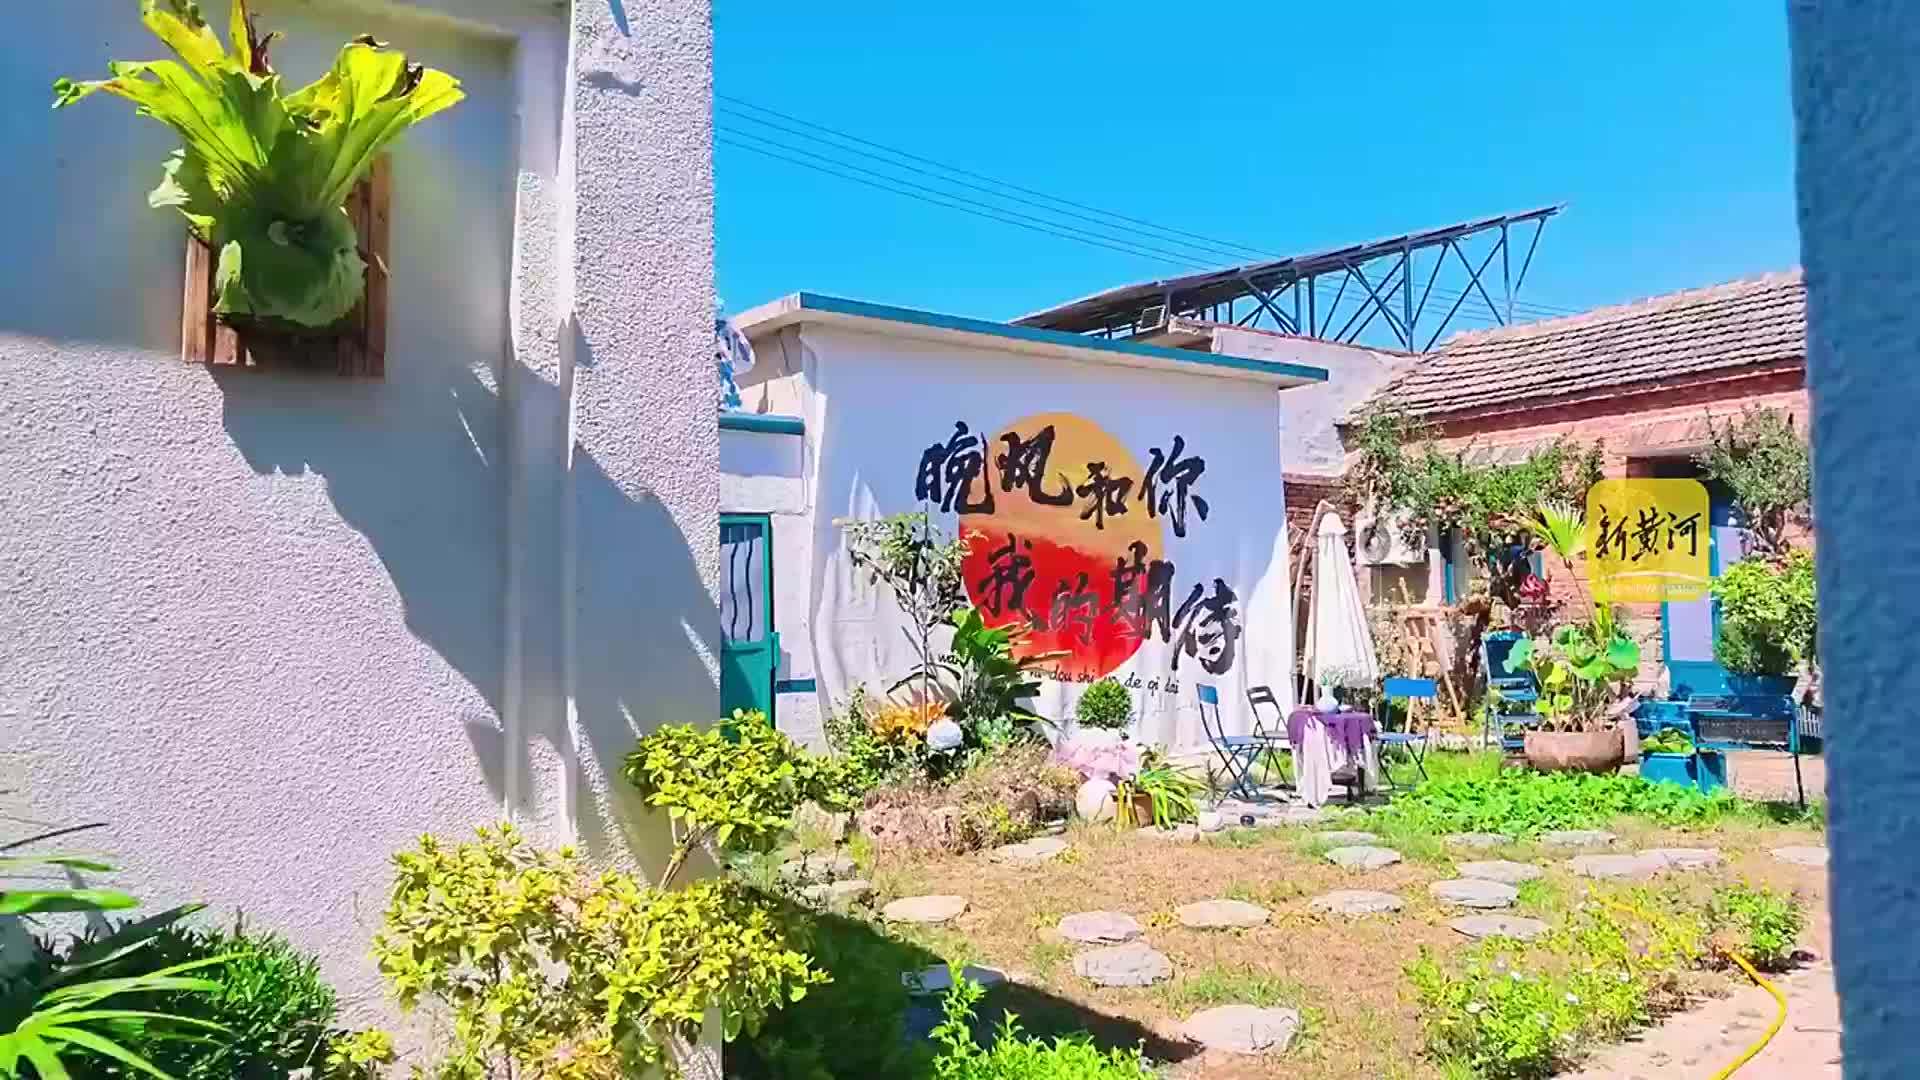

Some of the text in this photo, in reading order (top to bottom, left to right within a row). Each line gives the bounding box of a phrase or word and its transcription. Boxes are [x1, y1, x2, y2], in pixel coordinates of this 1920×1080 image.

[914, 420, 1210, 538] 晚风和你
[908, 533, 1242, 675] 我的期待
[1124, 671, 1142, 689] de
